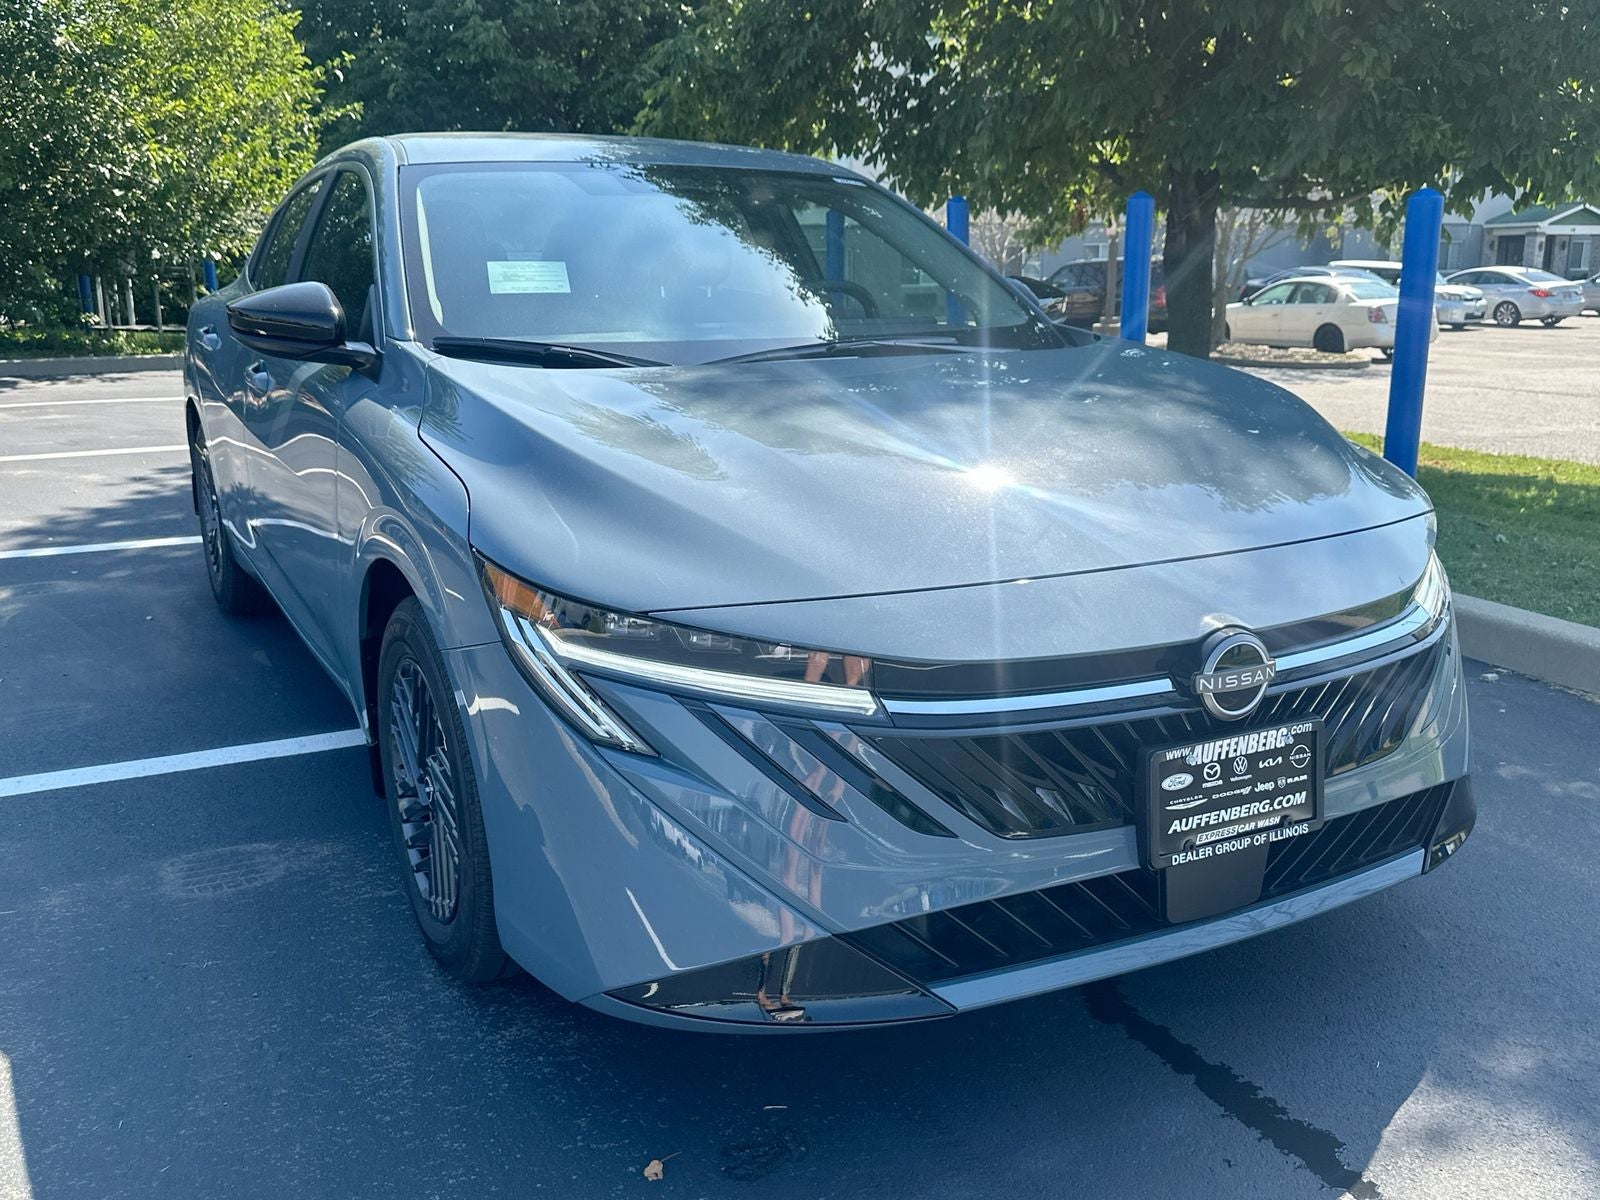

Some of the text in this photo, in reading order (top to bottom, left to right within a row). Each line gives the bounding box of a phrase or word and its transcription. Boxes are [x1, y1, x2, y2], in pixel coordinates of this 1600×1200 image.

[1199, 665, 1275, 691] NISSAN
[1254, 781, 1275, 792] Jeep
[1287, 774, 1308, 784] RAM
[1167, 791, 1307, 834] AUFFENBERG.COM
[1169, 795, 1203, 805] CHRYSLER
[1198, 816, 1280, 843] EXPRESS CAR WASH
[1172, 823, 1309, 866] DEALER GROUP OF ILLINOIS
